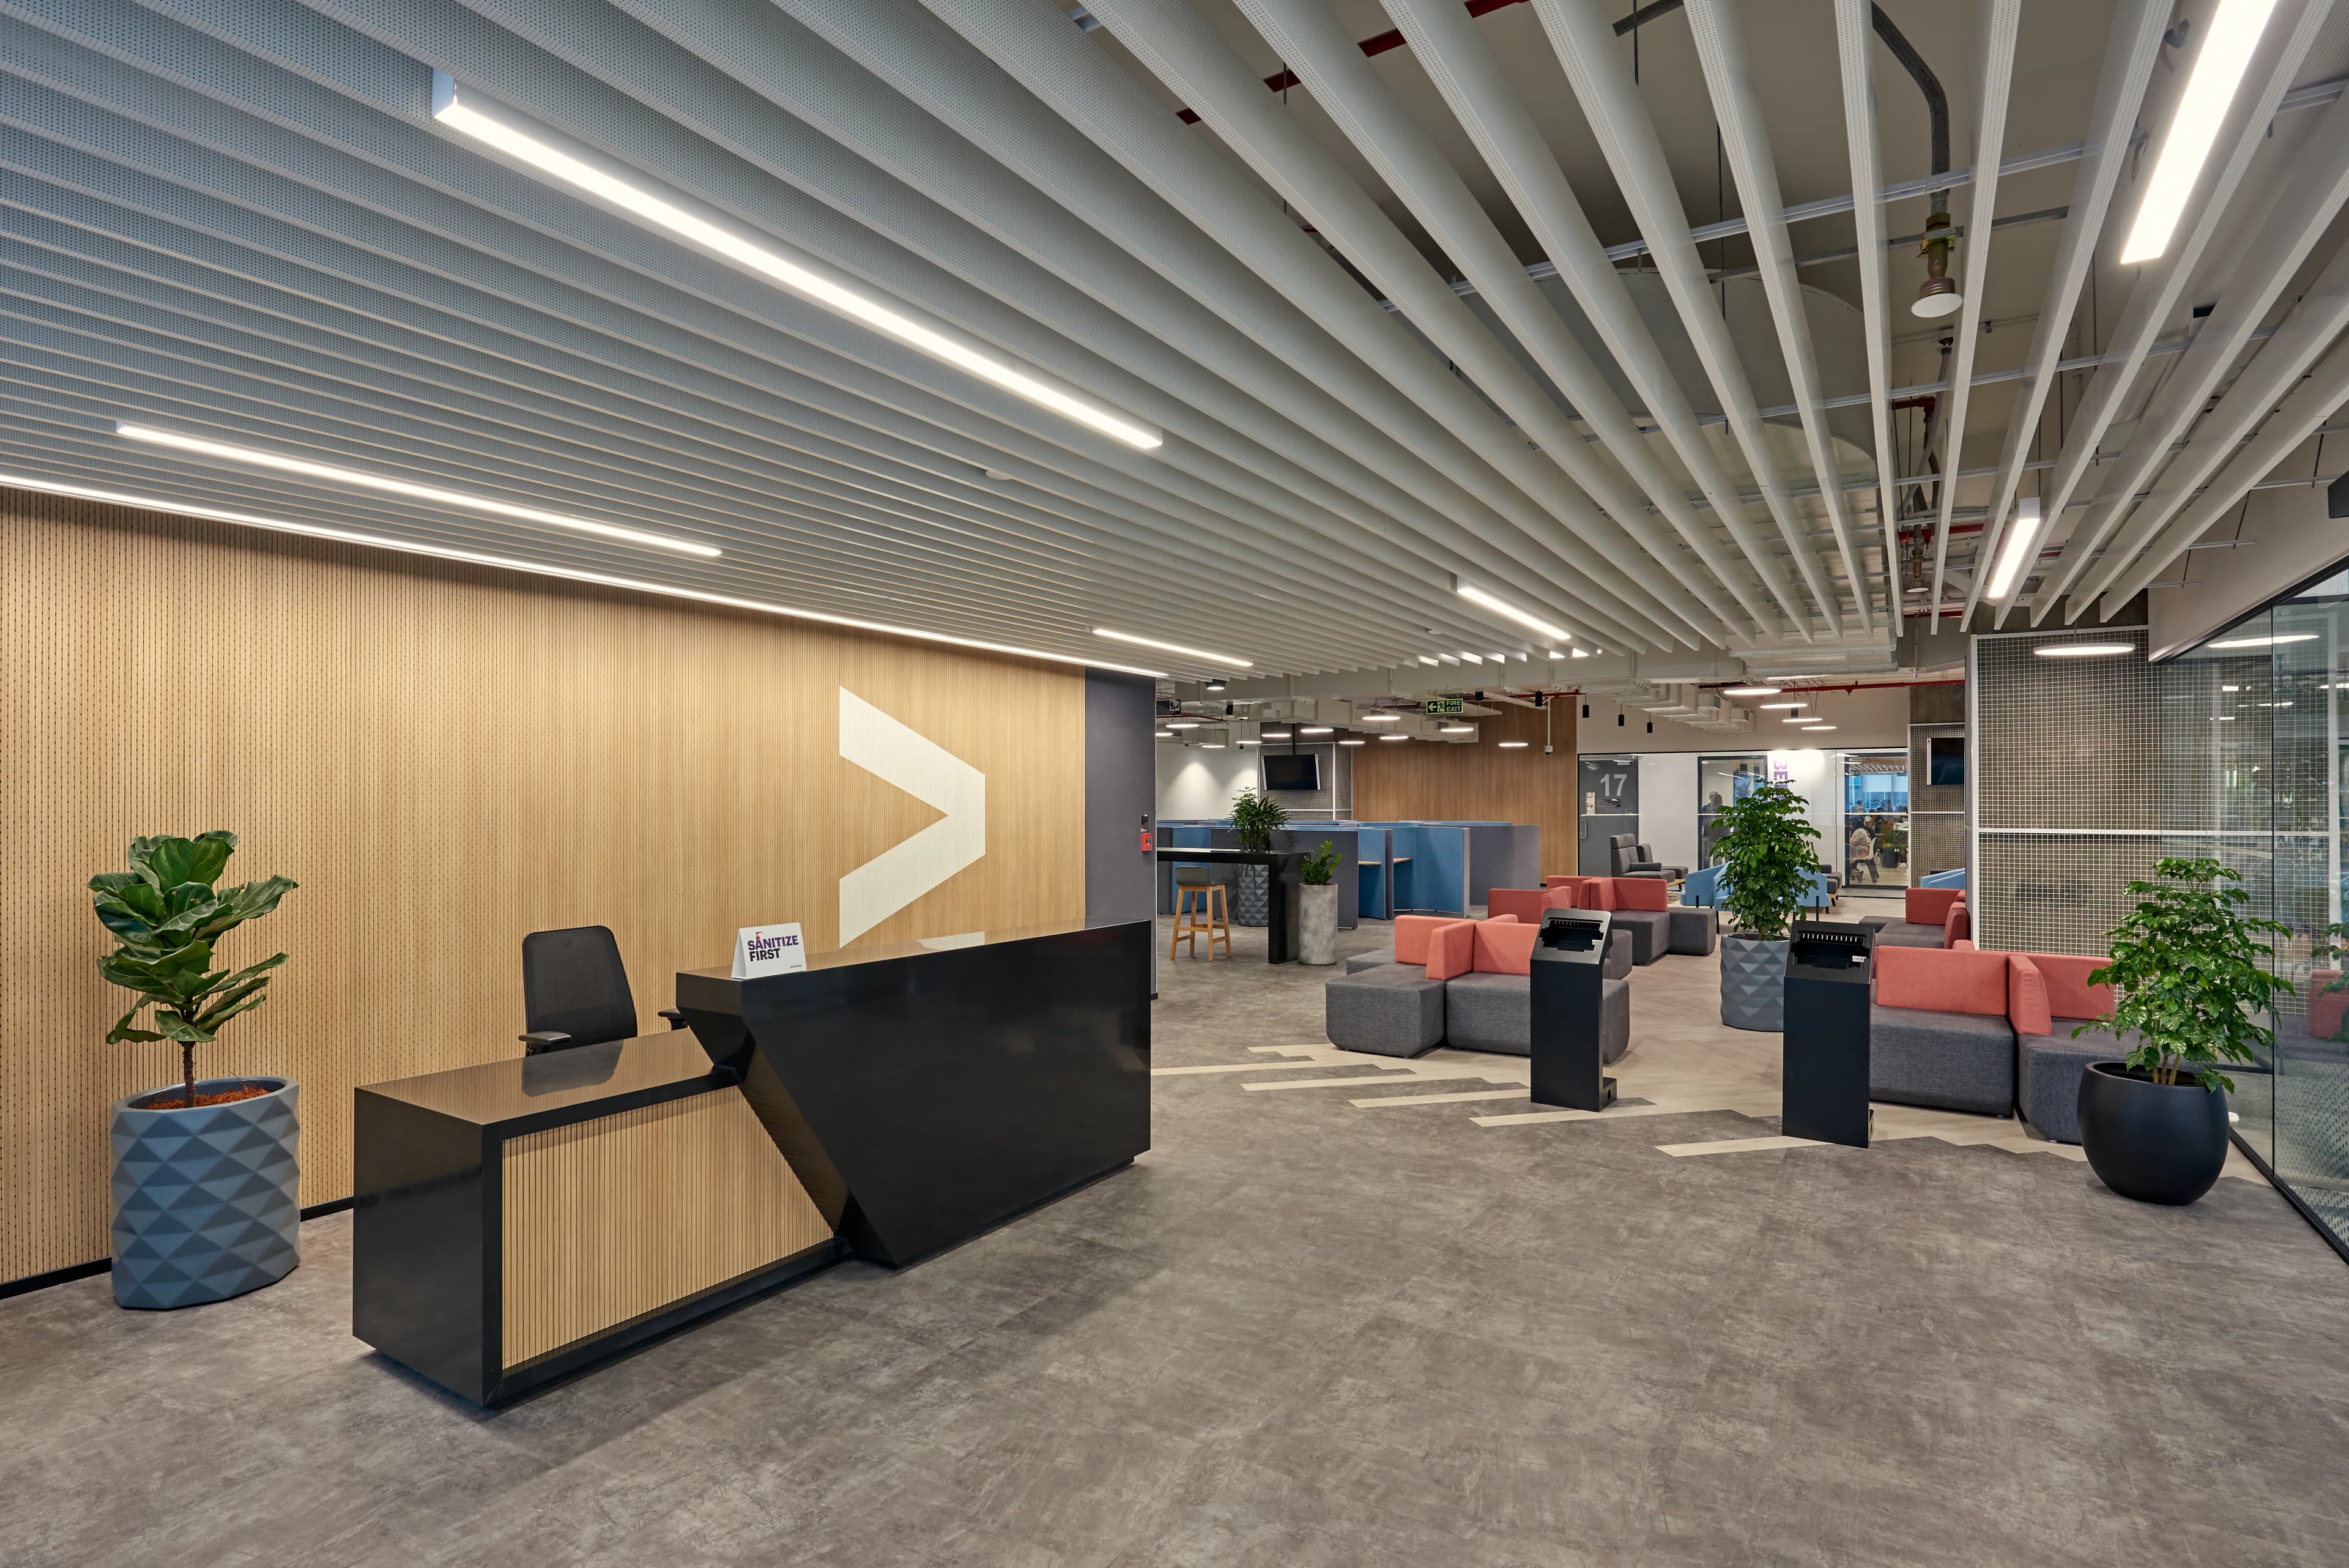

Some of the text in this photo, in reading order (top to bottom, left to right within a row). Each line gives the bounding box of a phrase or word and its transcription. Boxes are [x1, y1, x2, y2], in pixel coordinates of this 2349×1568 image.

[1600, 774, 1627, 797] 17
[748, 935, 799, 951] SANITIZE
[749, 948, 780, 962] FIRST
